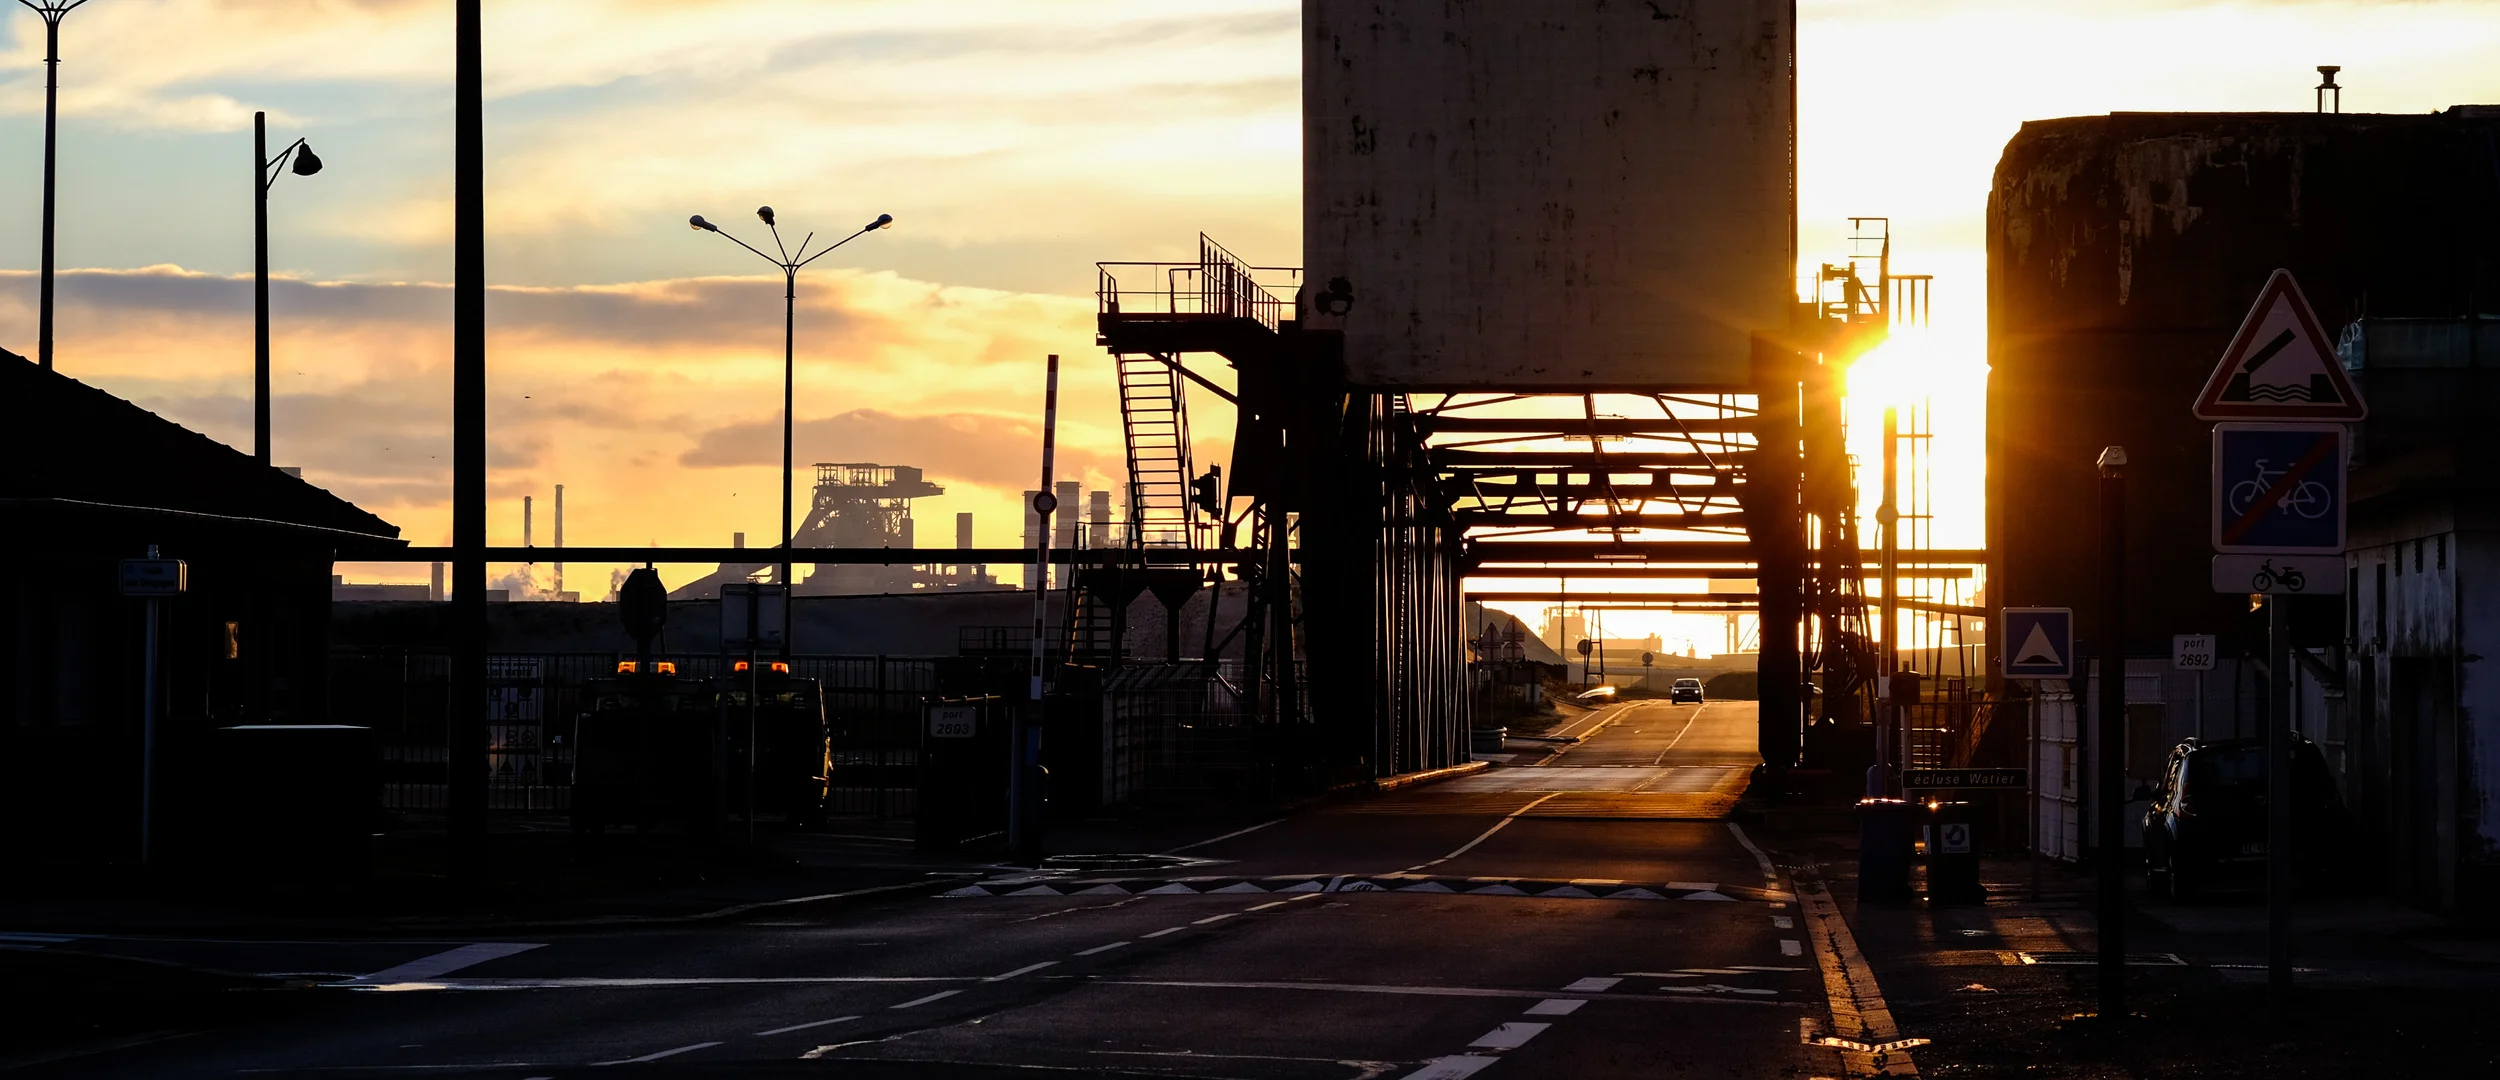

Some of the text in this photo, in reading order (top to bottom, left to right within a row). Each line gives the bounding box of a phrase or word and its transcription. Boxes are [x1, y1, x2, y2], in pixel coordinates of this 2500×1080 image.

[2183, 639, 2205, 650] port
[2179, 653, 2210, 666] 2692
[942, 711, 963, 720] port
[936, 723, 970, 735] 2693
[1914, 773, 2016, 785] écluse Watier
